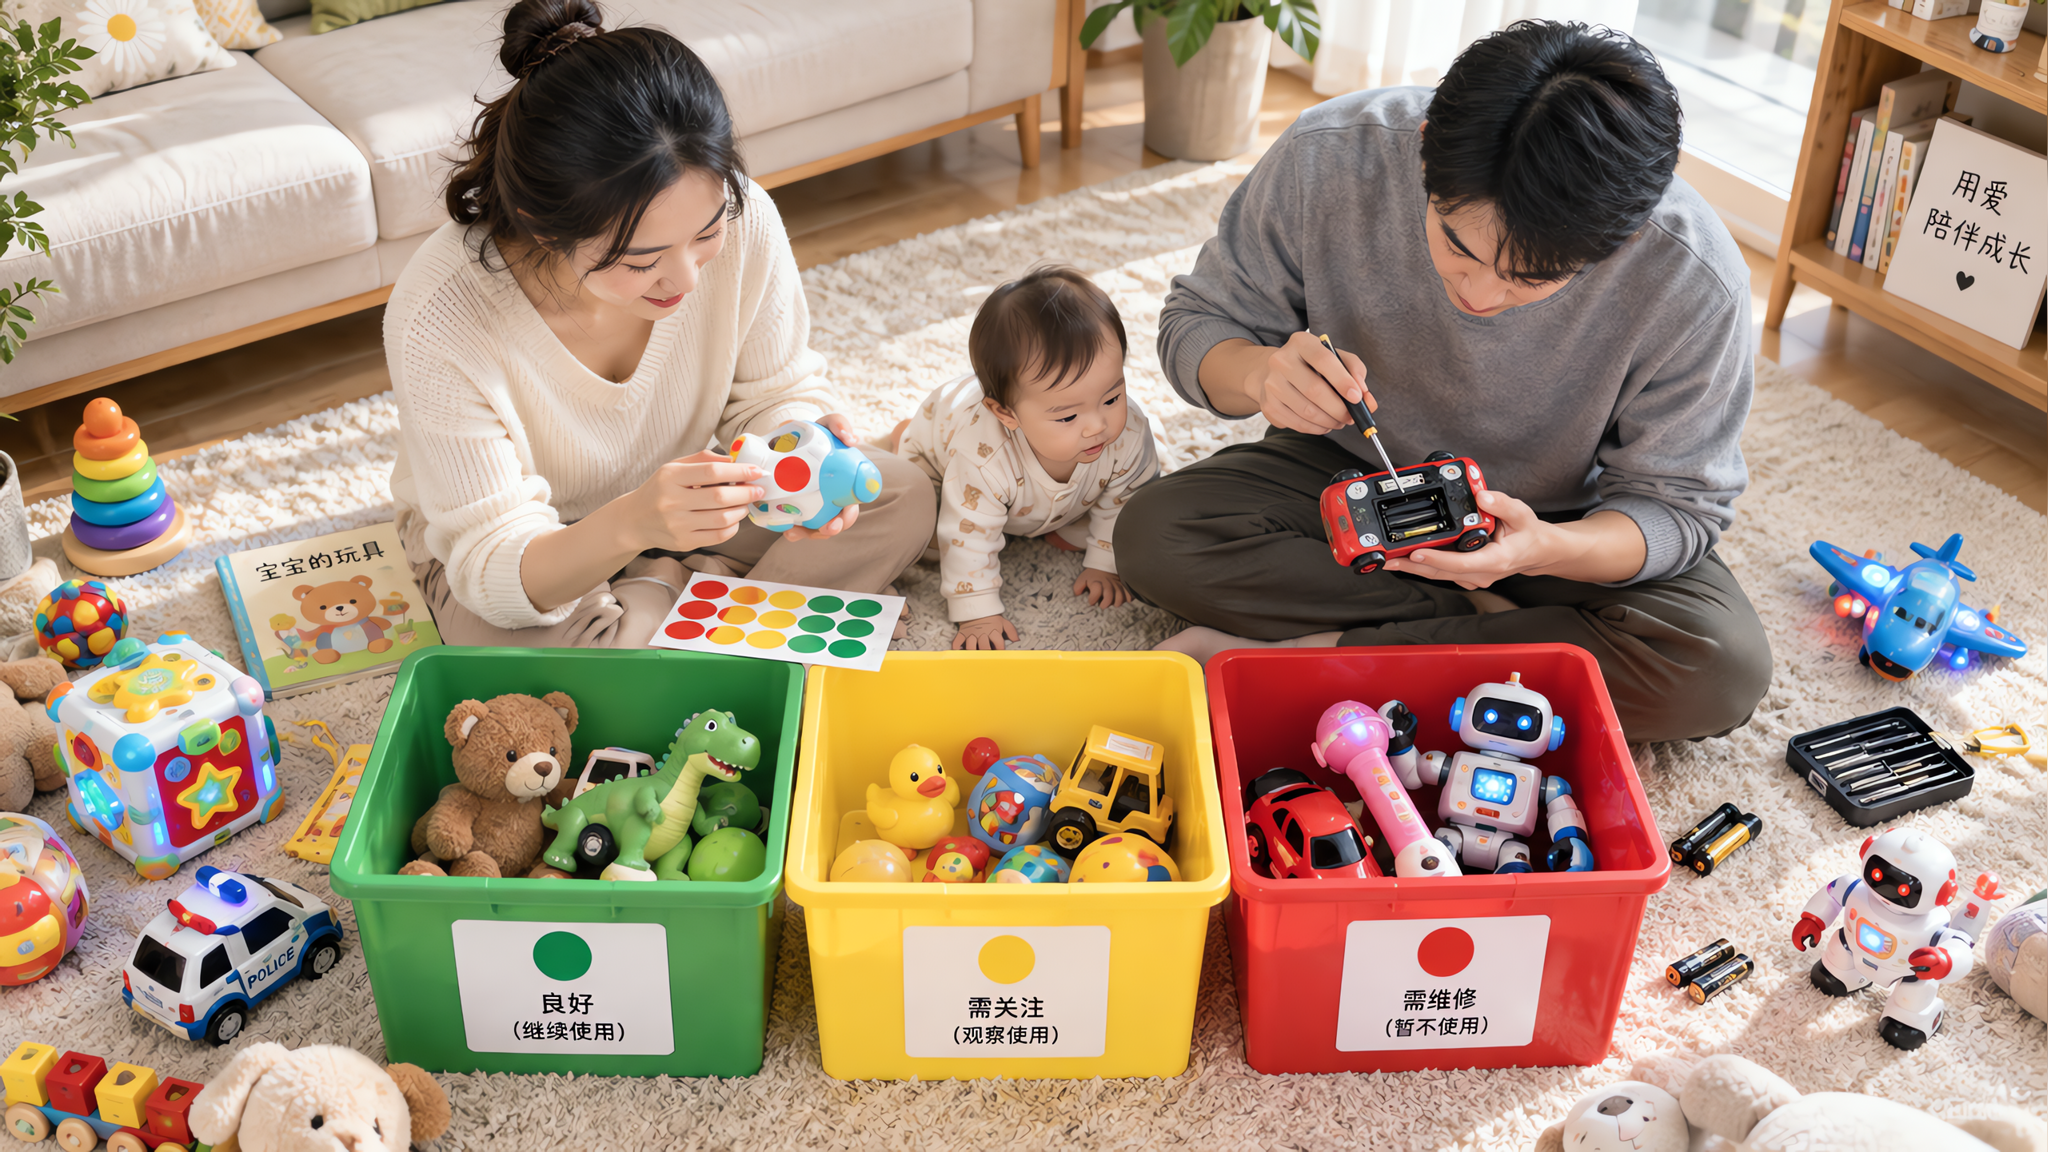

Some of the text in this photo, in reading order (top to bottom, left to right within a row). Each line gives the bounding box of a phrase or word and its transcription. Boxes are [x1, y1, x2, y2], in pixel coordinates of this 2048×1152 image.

[1952, 170, 2008, 216] 用爱
[1923, 208, 2031, 275] 陪伴成长
[255, 540, 385, 583] 宝宝的玩具
[247, 946, 295, 989] POLICE
[542, 992, 594, 1015] 良好
[968, 996, 1045, 1019] 需关注
[1403, 987, 1477, 1011] 需维修
[513, 1020, 625, 1042] （继续使用）
[953, 1025, 1059, 1045] （观察使用）
